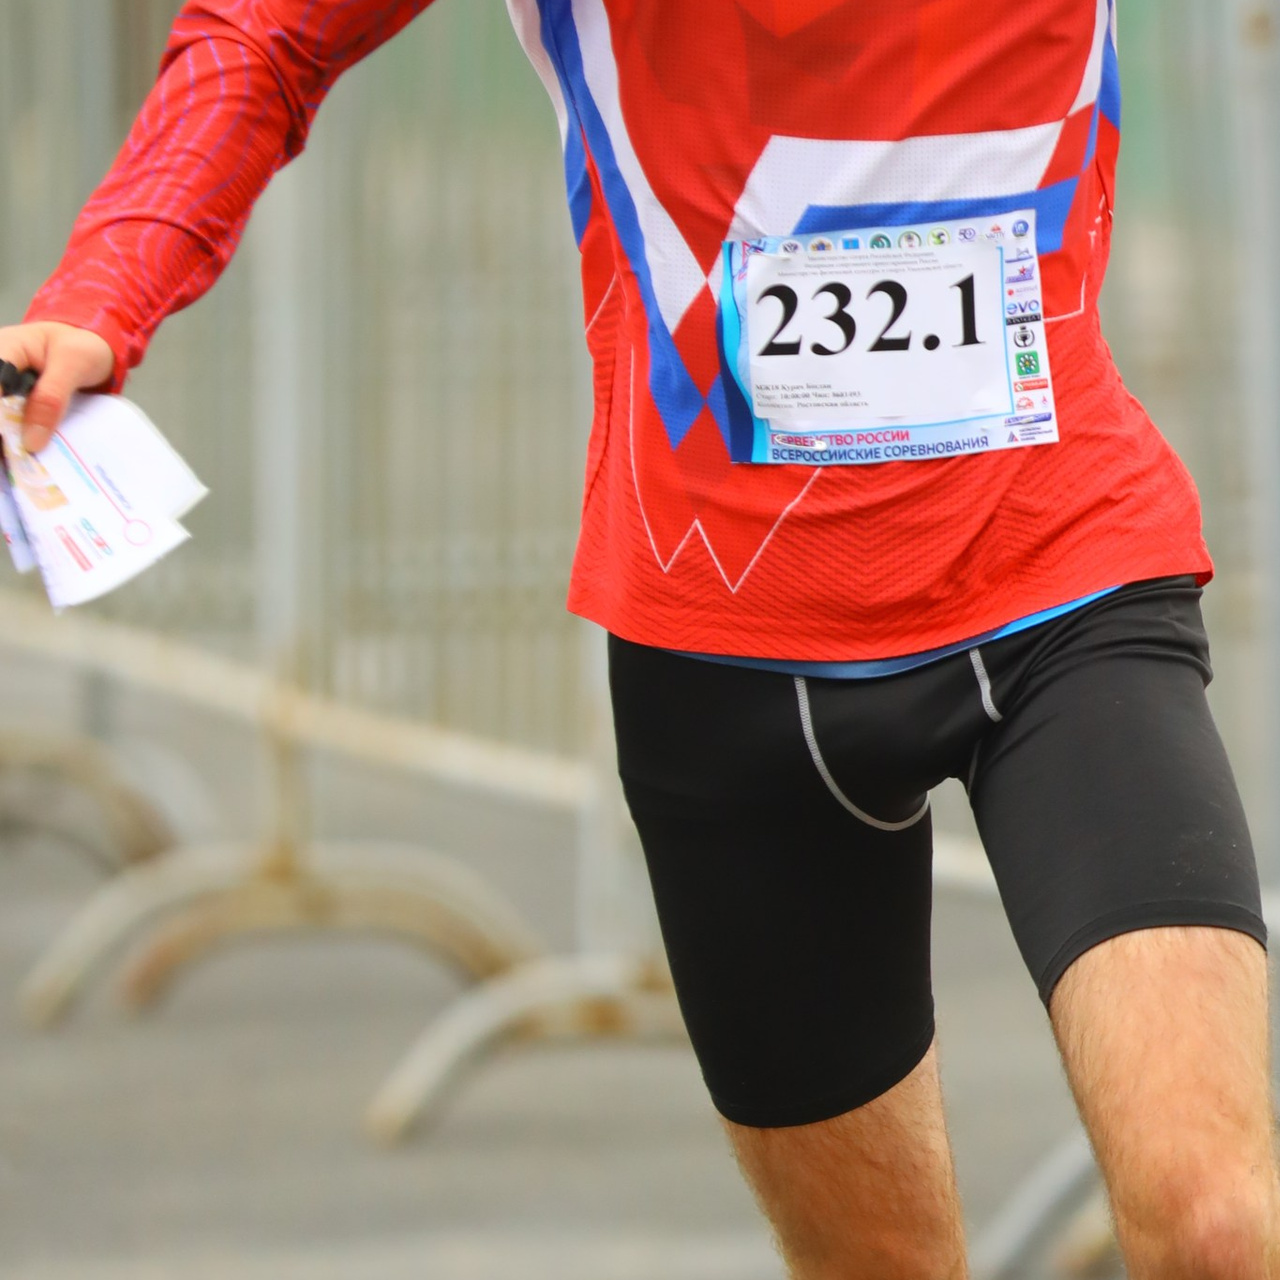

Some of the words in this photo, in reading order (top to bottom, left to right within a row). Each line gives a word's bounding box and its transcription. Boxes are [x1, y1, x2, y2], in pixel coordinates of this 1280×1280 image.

[756, 272, 986, 357] 232.1
[856, 430, 910, 444] РОССИИ
[884, 436, 989, 458] СОРЕВНОВАНИЯ
